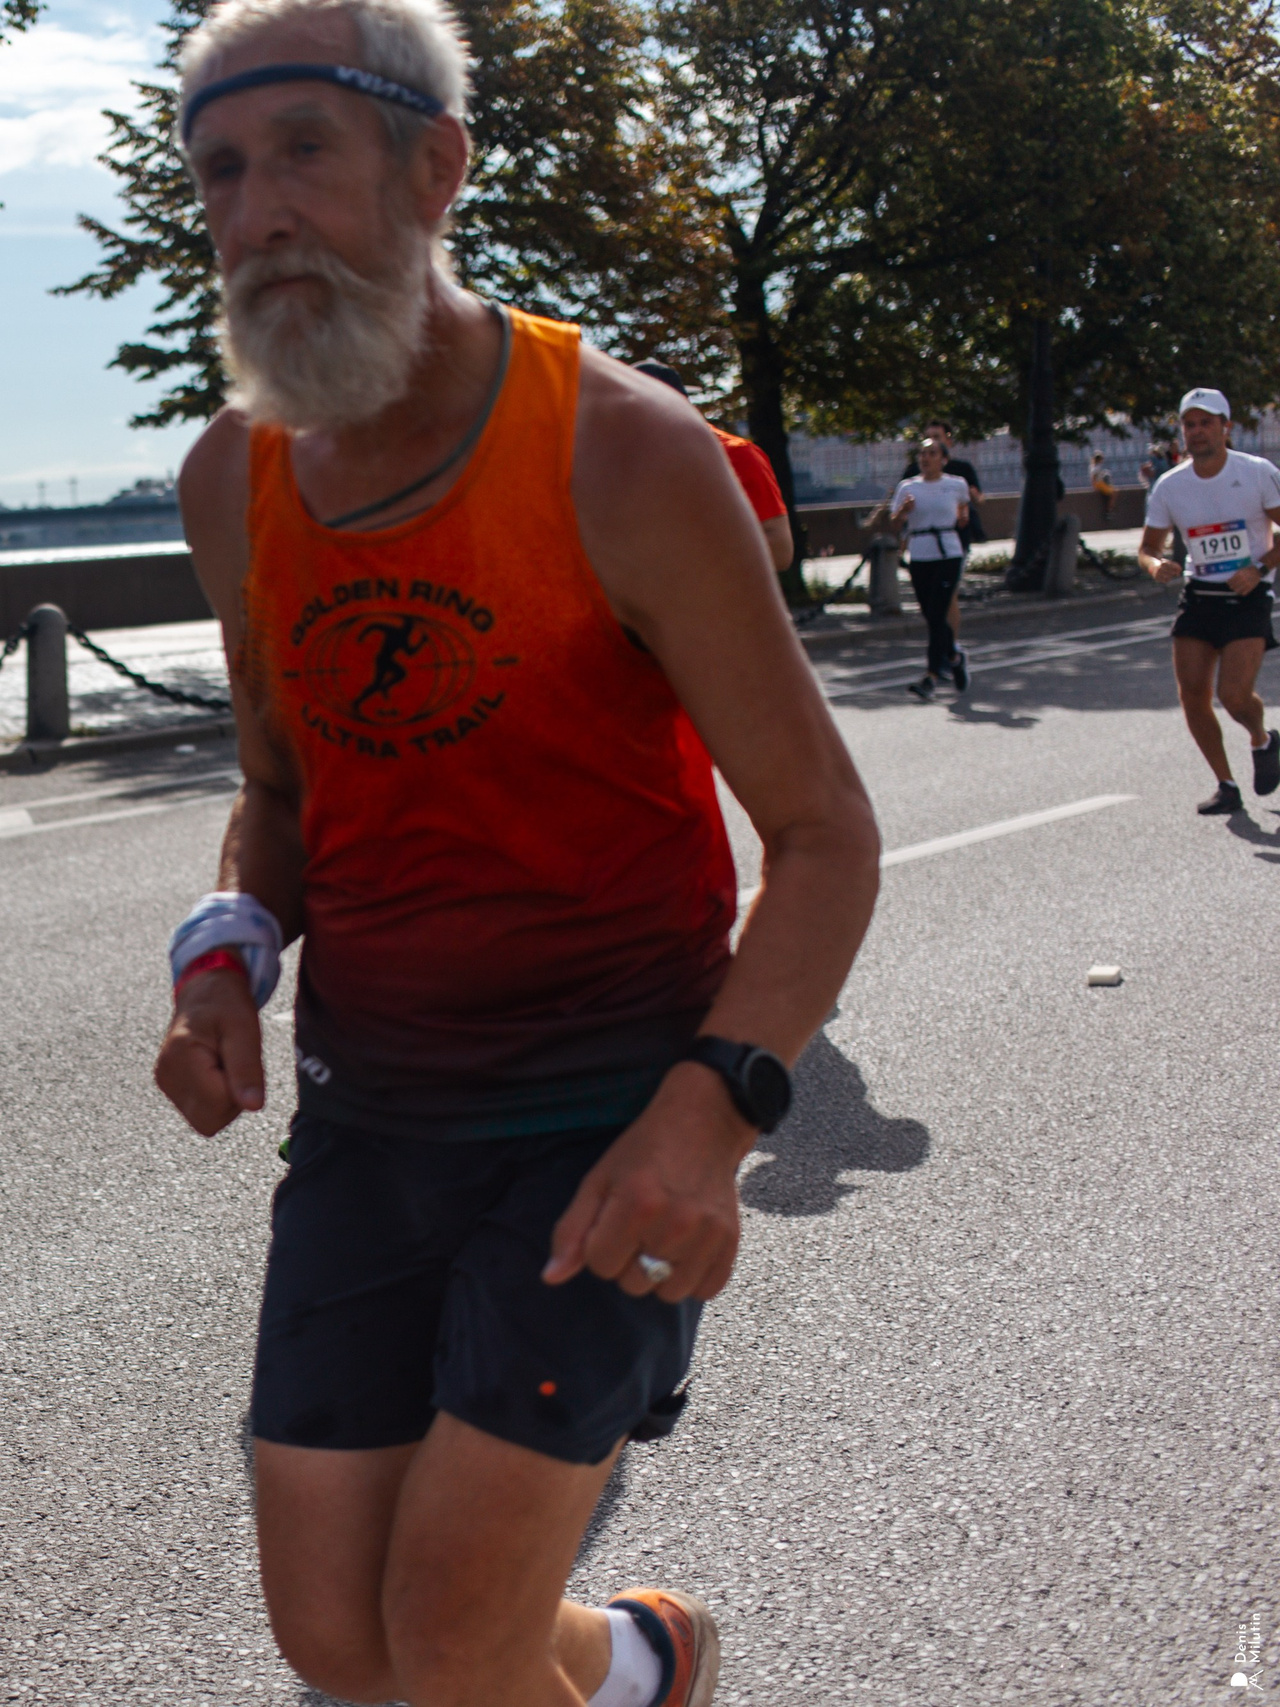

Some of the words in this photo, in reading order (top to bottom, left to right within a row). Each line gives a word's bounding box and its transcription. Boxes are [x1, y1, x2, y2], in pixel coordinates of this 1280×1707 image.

[1200, 534, 1242, 555] 1910
[301, 702, 400, 759] ULTRA
[409, 691, 506, 754] TRAIL
